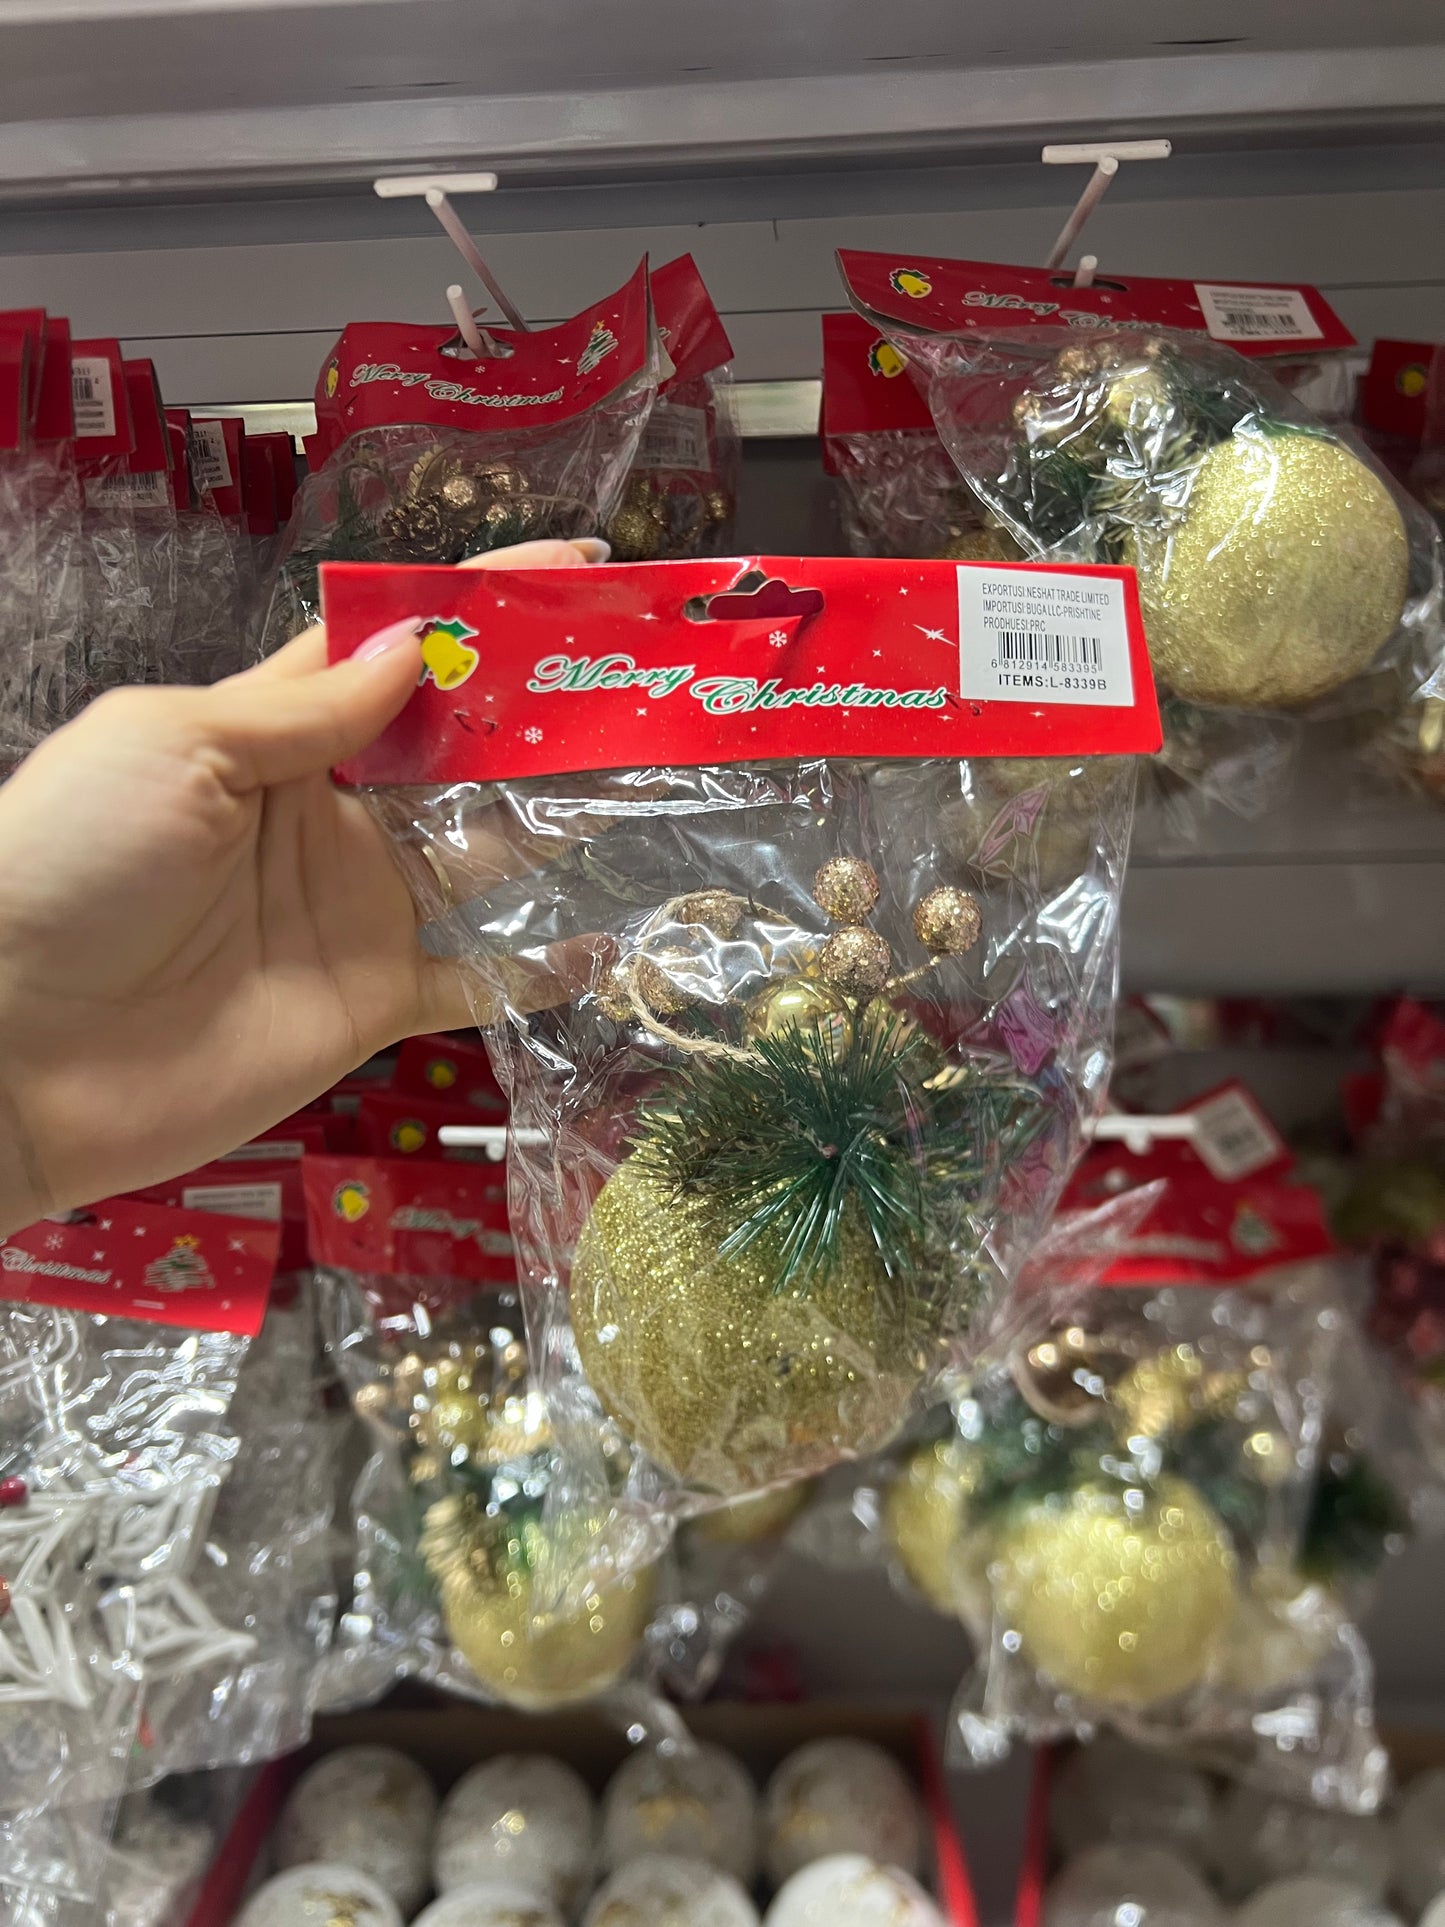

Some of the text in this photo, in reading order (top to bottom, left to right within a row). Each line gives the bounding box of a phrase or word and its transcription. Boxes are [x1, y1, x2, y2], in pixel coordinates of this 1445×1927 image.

[349, 363, 432, 387] Merry
[424, 379, 565, 408] Christmas
[1057, 588, 1081, 602] TRADE
[1081, 591, 1110, 606] LIMITED
[527, 653, 696, 699] Merry
[1003, 659, 1048, 671] 812914
[1053, 664, 1098, 674] 583395
[998, 673, 1108, 691] ITEMS:L-8339B
[689, 676, 950, 716] Christmas
